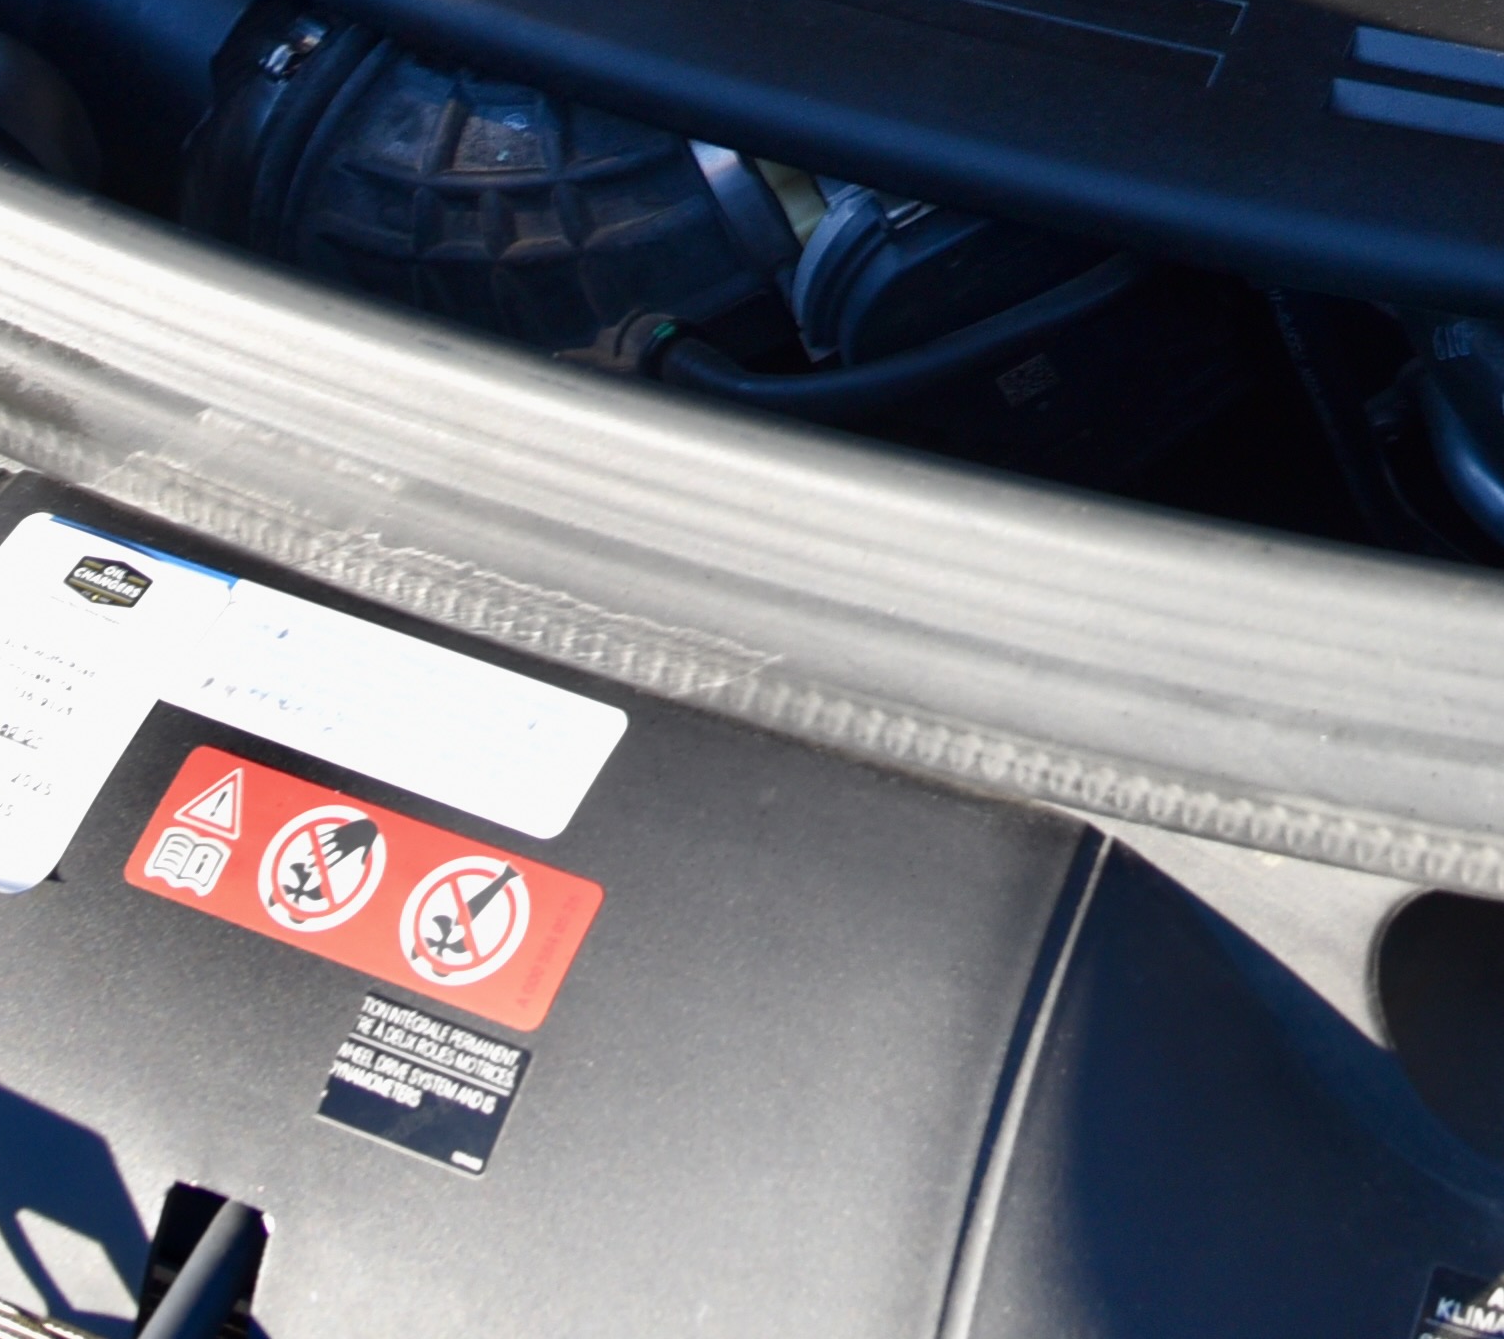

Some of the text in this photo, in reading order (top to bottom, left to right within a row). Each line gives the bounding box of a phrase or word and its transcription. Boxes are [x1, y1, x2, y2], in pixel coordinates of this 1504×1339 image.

[74, 567, 142, 598] CHANGERS
[103, 565, 128, 580] OIL
[389, 1006, 451, 1042] INTÉGRALE
[383, 1027, 415, 1050] DEUX
[415, 1036, 455, 1066] ROUES
[374, 1054, 409, 1081] DRIVE
[408, 1068, 459, 1099] SYSTEM
[455, 1085, 484, 1110] AND
